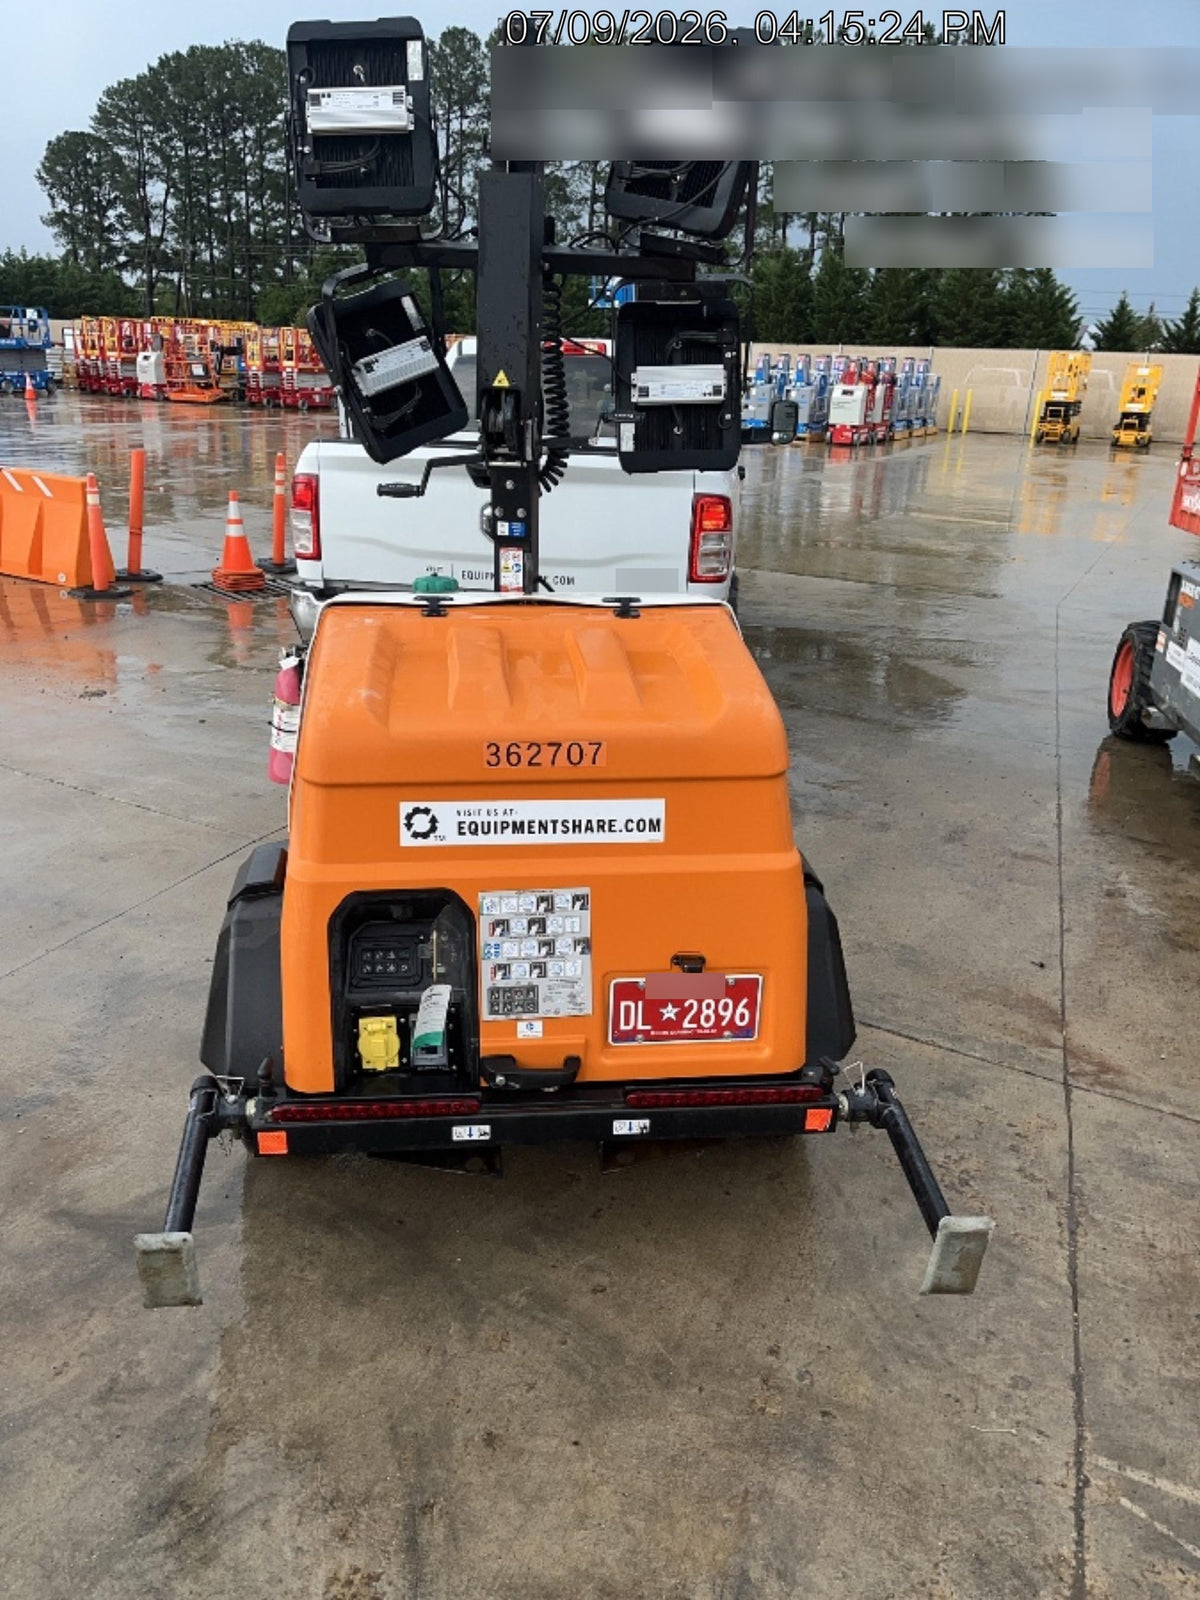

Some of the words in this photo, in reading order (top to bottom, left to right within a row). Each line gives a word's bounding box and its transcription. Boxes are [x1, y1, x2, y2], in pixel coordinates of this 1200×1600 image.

[486, 742, 602, 767] 362707
[456, 808, 482, 817] VISIT
[487, 808, 499, 817] US
[457, 817, 661, 836] EQUIPMENTSHARE.COM
[619, 1000, 652, 1030] DL
[682, 998, 750, 1028] 2896
